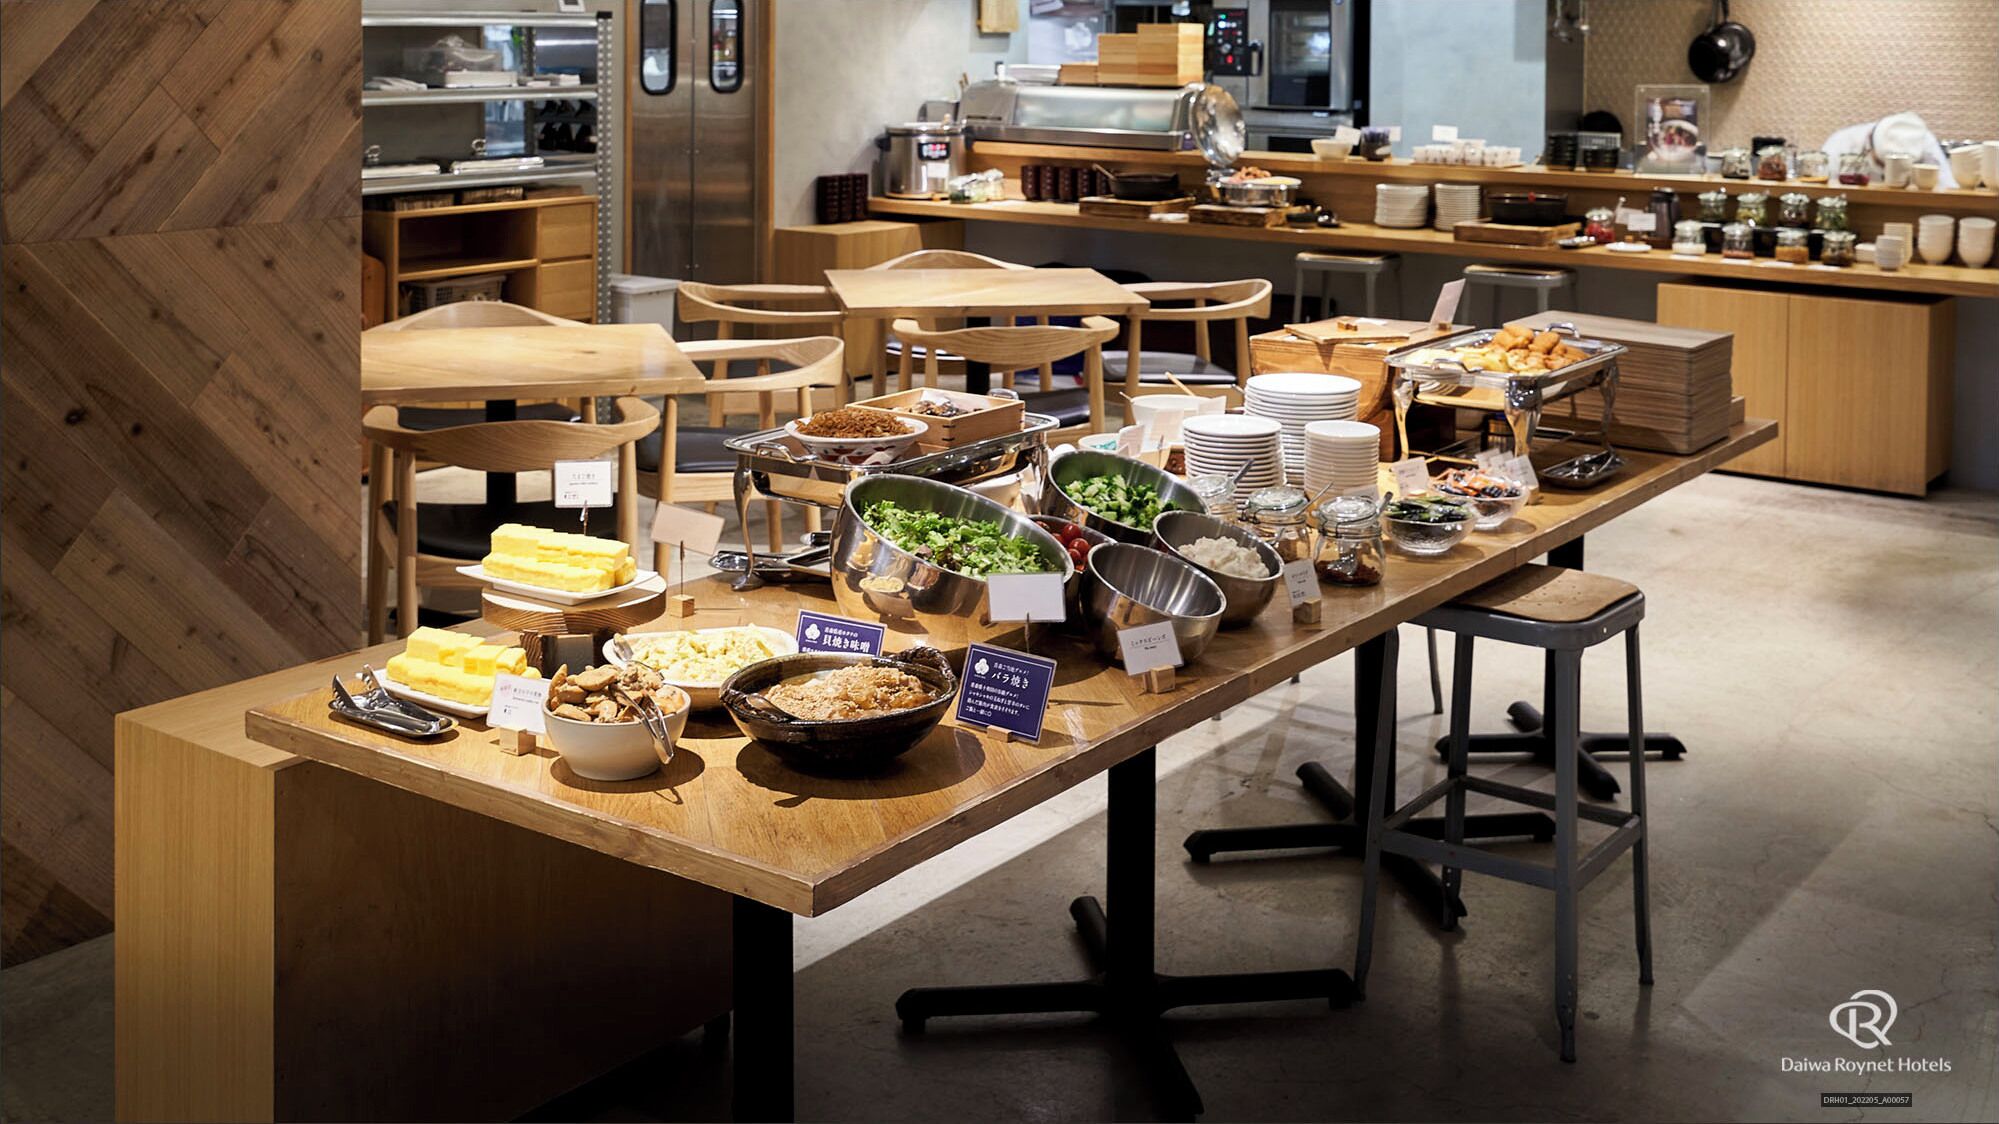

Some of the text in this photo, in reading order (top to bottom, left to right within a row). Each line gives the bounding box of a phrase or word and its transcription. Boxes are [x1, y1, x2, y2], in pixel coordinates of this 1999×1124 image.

[822, 634, 870, 653] 貝焼き味噌
[991, 671, 1029, 689] バラ焼き
